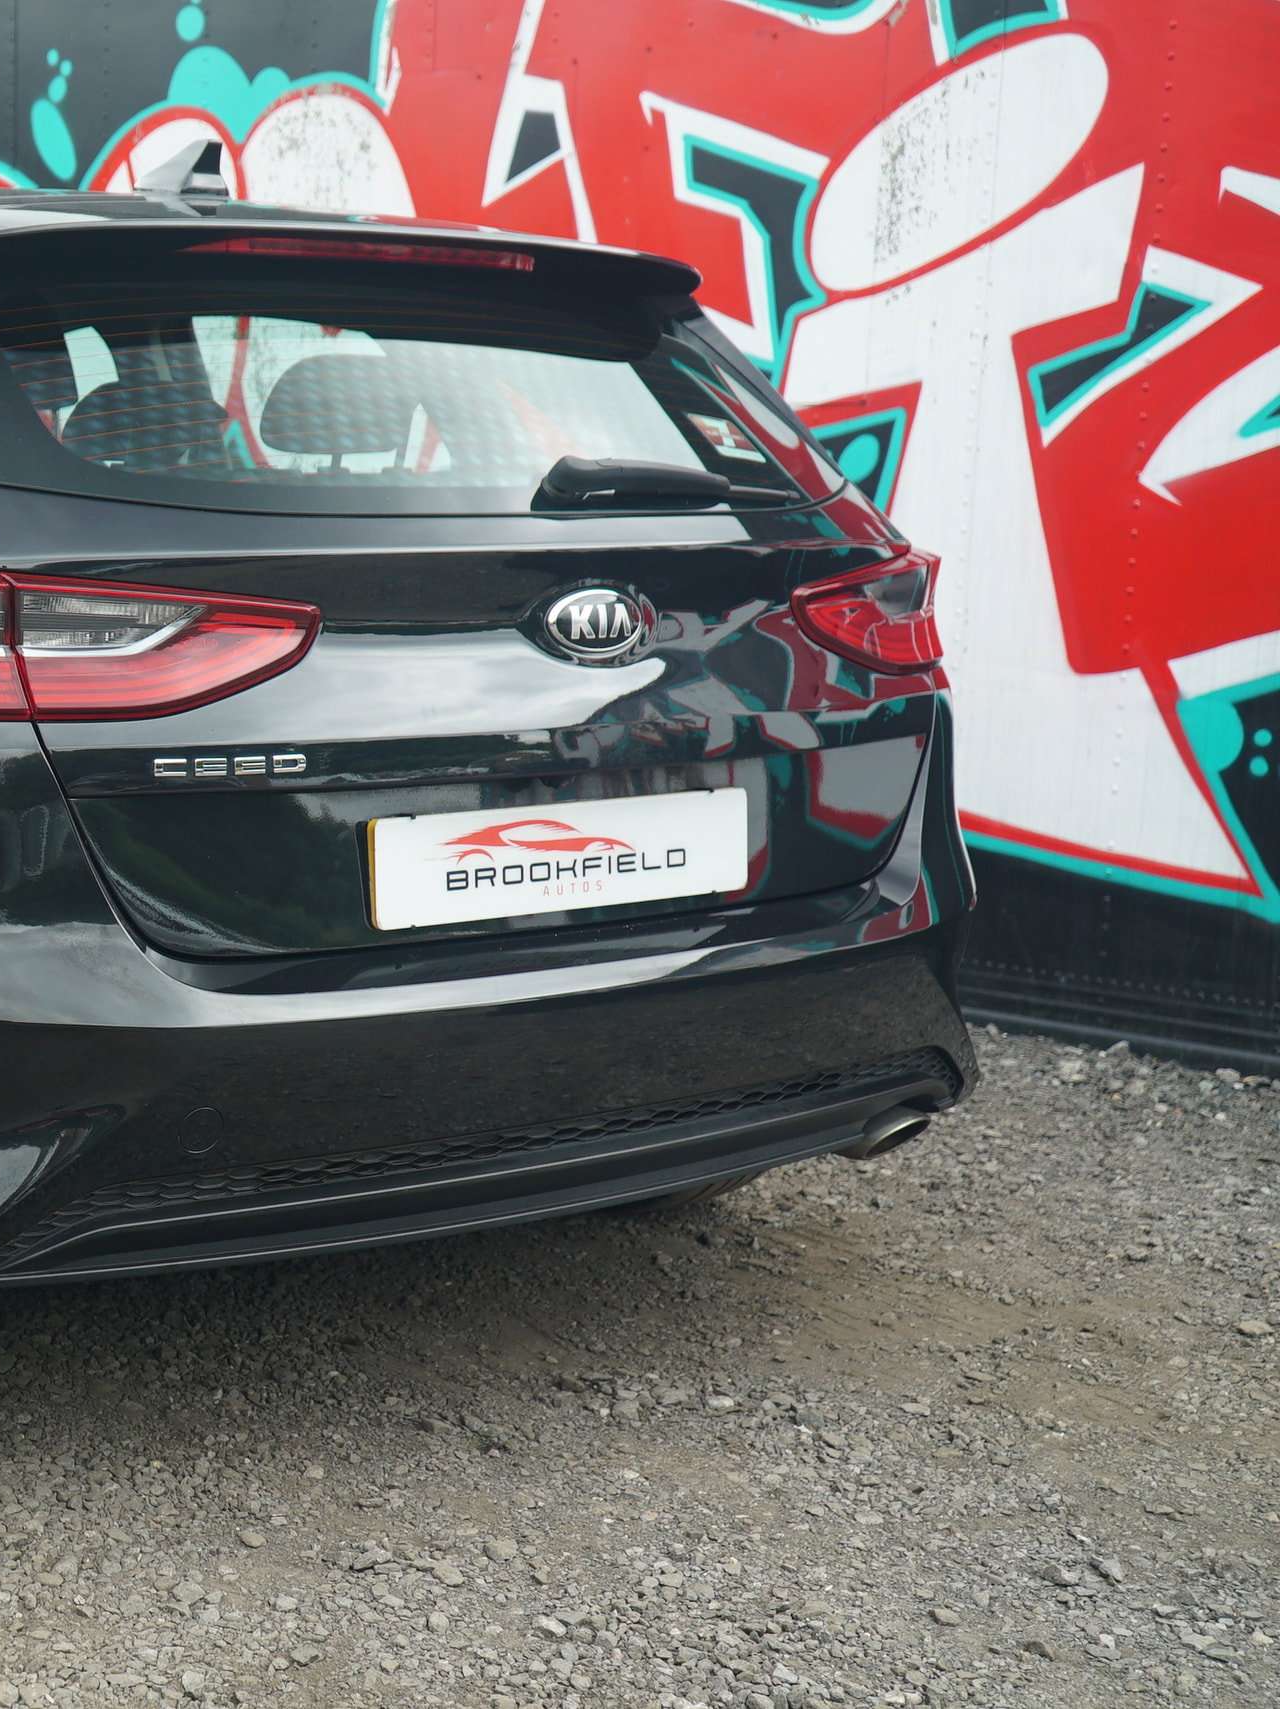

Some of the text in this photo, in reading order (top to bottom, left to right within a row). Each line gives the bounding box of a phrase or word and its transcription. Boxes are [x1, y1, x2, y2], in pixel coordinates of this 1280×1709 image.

[568, 602, 632, 640] KIA
[153, 753, 307, 778] CEED
[445, 847, 687, 892] BROOKFIELD
[542, 879, 604, 898] AUTOS
